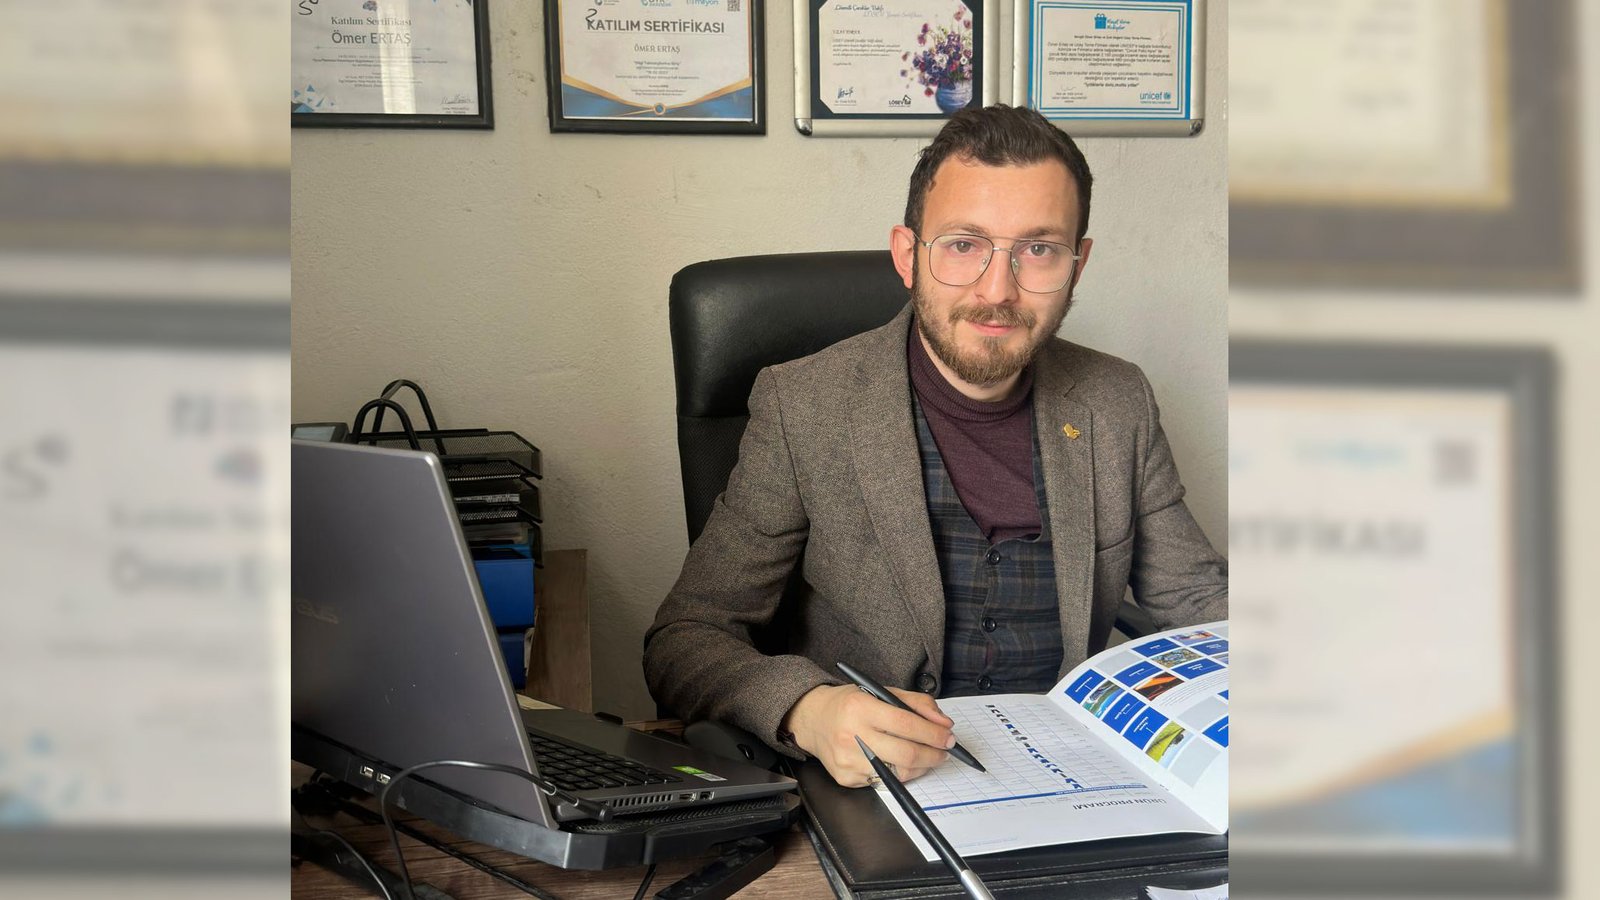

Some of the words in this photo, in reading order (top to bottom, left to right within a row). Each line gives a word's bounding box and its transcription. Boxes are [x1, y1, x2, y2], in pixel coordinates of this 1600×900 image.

[331, 16, 364, 26] Katılım
[366, 16, 412, 27] Sertifikası
[587, 20, 641, 32] KATILIM
[644, 18, 725, 33] SERTİFİKASI
[331, 30, 367, 44] Ömer
[370, 32, 412, 47] ERTAŞ
[634, 43, 656, 52] ÖMER
[657, 45, 681, 54] ERTAŞ
[1140, 91, 1163, 100] unicef
[1072, 799, 1135, 811] PROGRAMI
